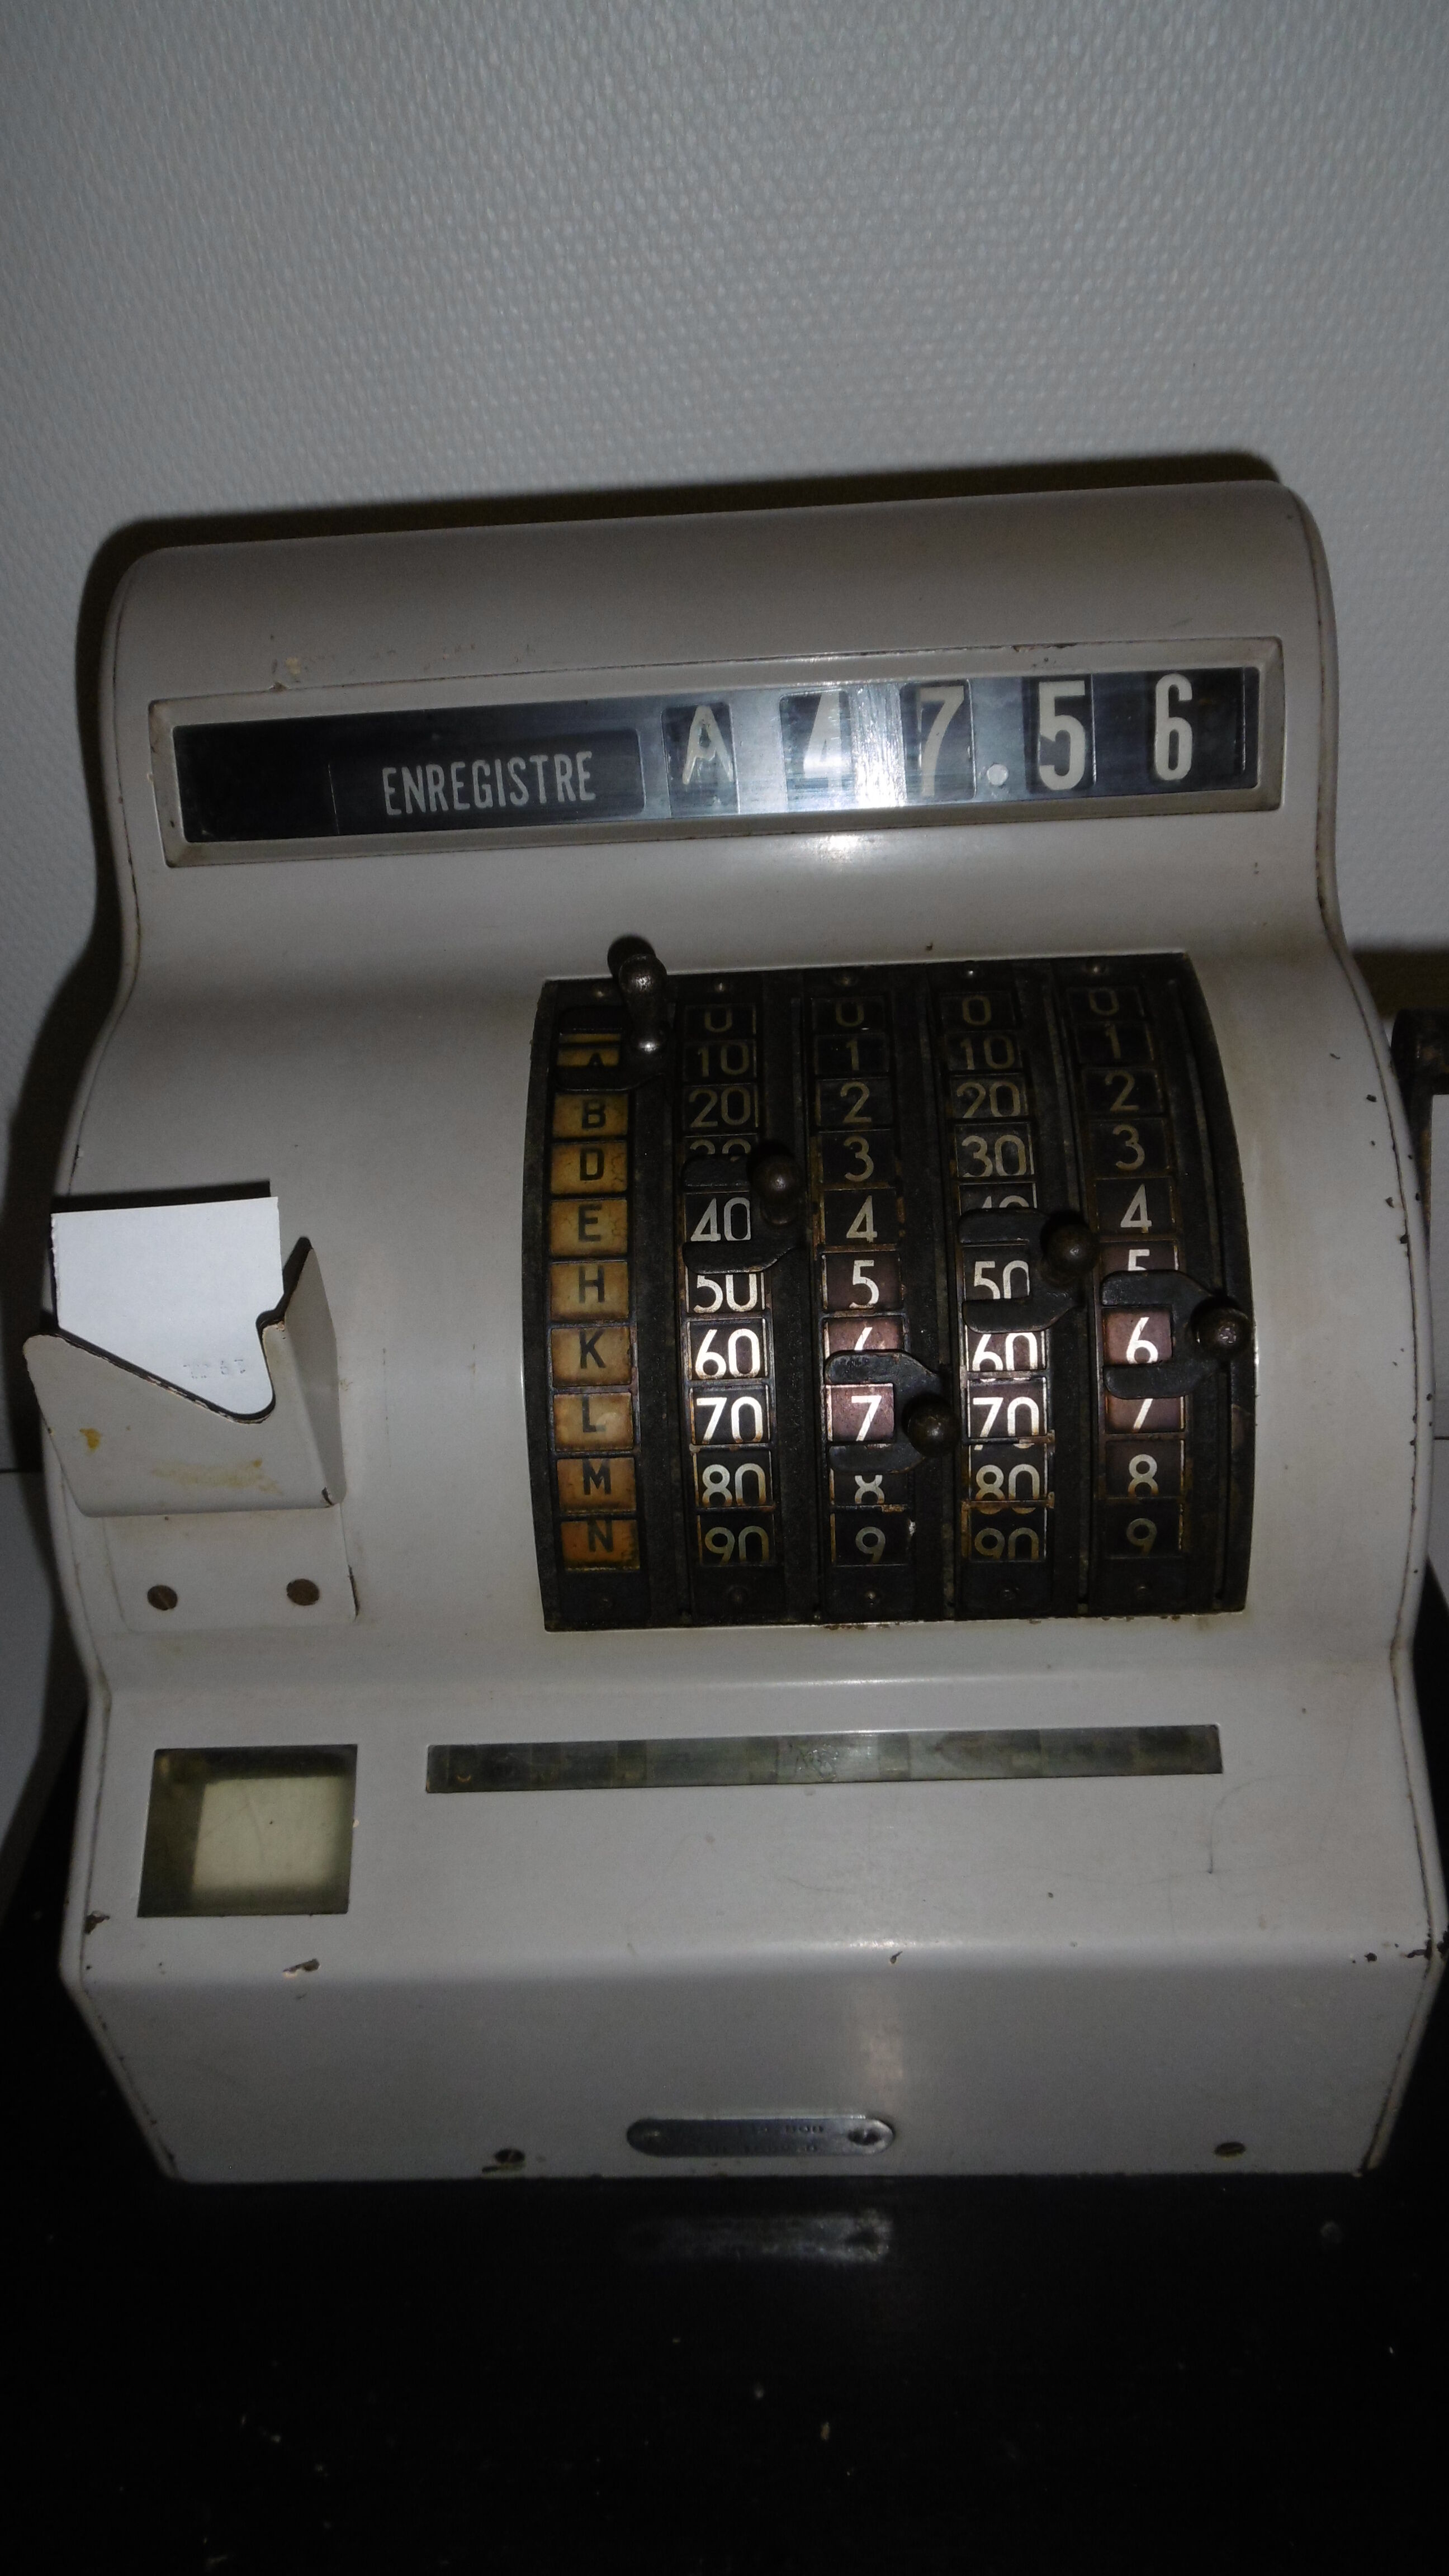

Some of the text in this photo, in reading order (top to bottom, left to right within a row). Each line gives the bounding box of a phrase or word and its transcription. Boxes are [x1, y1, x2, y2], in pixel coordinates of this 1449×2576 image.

[684, 706, 733, 784] A
[1036, 681, 1086, 791] 5
[1154, 673, 1193, 781] 6
[382, 750, 596, 817] ENREGISTRE
[962, 995, 991, 1026] 0
[697, 1041, 750, 1077] 10
[845, 1040, 859, 1071] 1
[960, 1034, 1015, 1071] 10
[1105, 1024, 1121, 1059] 1
[689, 1085, 751, 1128] 20
[840, 1081, 872, 1123] 2
[956, 1081, 1020, 1118] 20
[1105, 1071, 1139, 1112] 2
[581, 1100, 607, 1129] B
[580, 1148, 604, 1181] D
[843, 1136, 874, 1182] 3
[962, 1135, 1026, 1177] 30
[1112, 1124, 1145, 1170] 3
[577, 1204, 603, 1242] E
[690, 1197, 751, 1241] 40
[846, 1195, 878, 1243] 4
[1120, 1184, 1152, 1233] 4
[578, 1265, 605, 1304] H
[693, 1273, 757, 1314] 50
[849, 1259, 879, 1308] 5
[577, 1330, 605, 1369] K
[695, 1328, 760, 1379] 60
[972, 1332, 1038, 1382] 60
[1126, 1317, 1158, 1364] 6
[581, 1395, 605, 1433] L
[696, 1396, 763, 1444] 70
[851, 1395, 882, 1441] 7
[973, 1396, 1039, 1451] 70
[583, 1460, 612, 1495] M
[702, 1463, 766, 1507] 80
[975, 1464, 1040, 1514] 80
[1128, 1454, 1159, 1500] 8
[588, 1520, 613, 1552] N
[704, 1526, 770, 1565] 90
[855, 1526, 886, 1564] 9
[974, 1527, 1039, 1560] 90
[1126, 1518, 1157, 1555] 9
